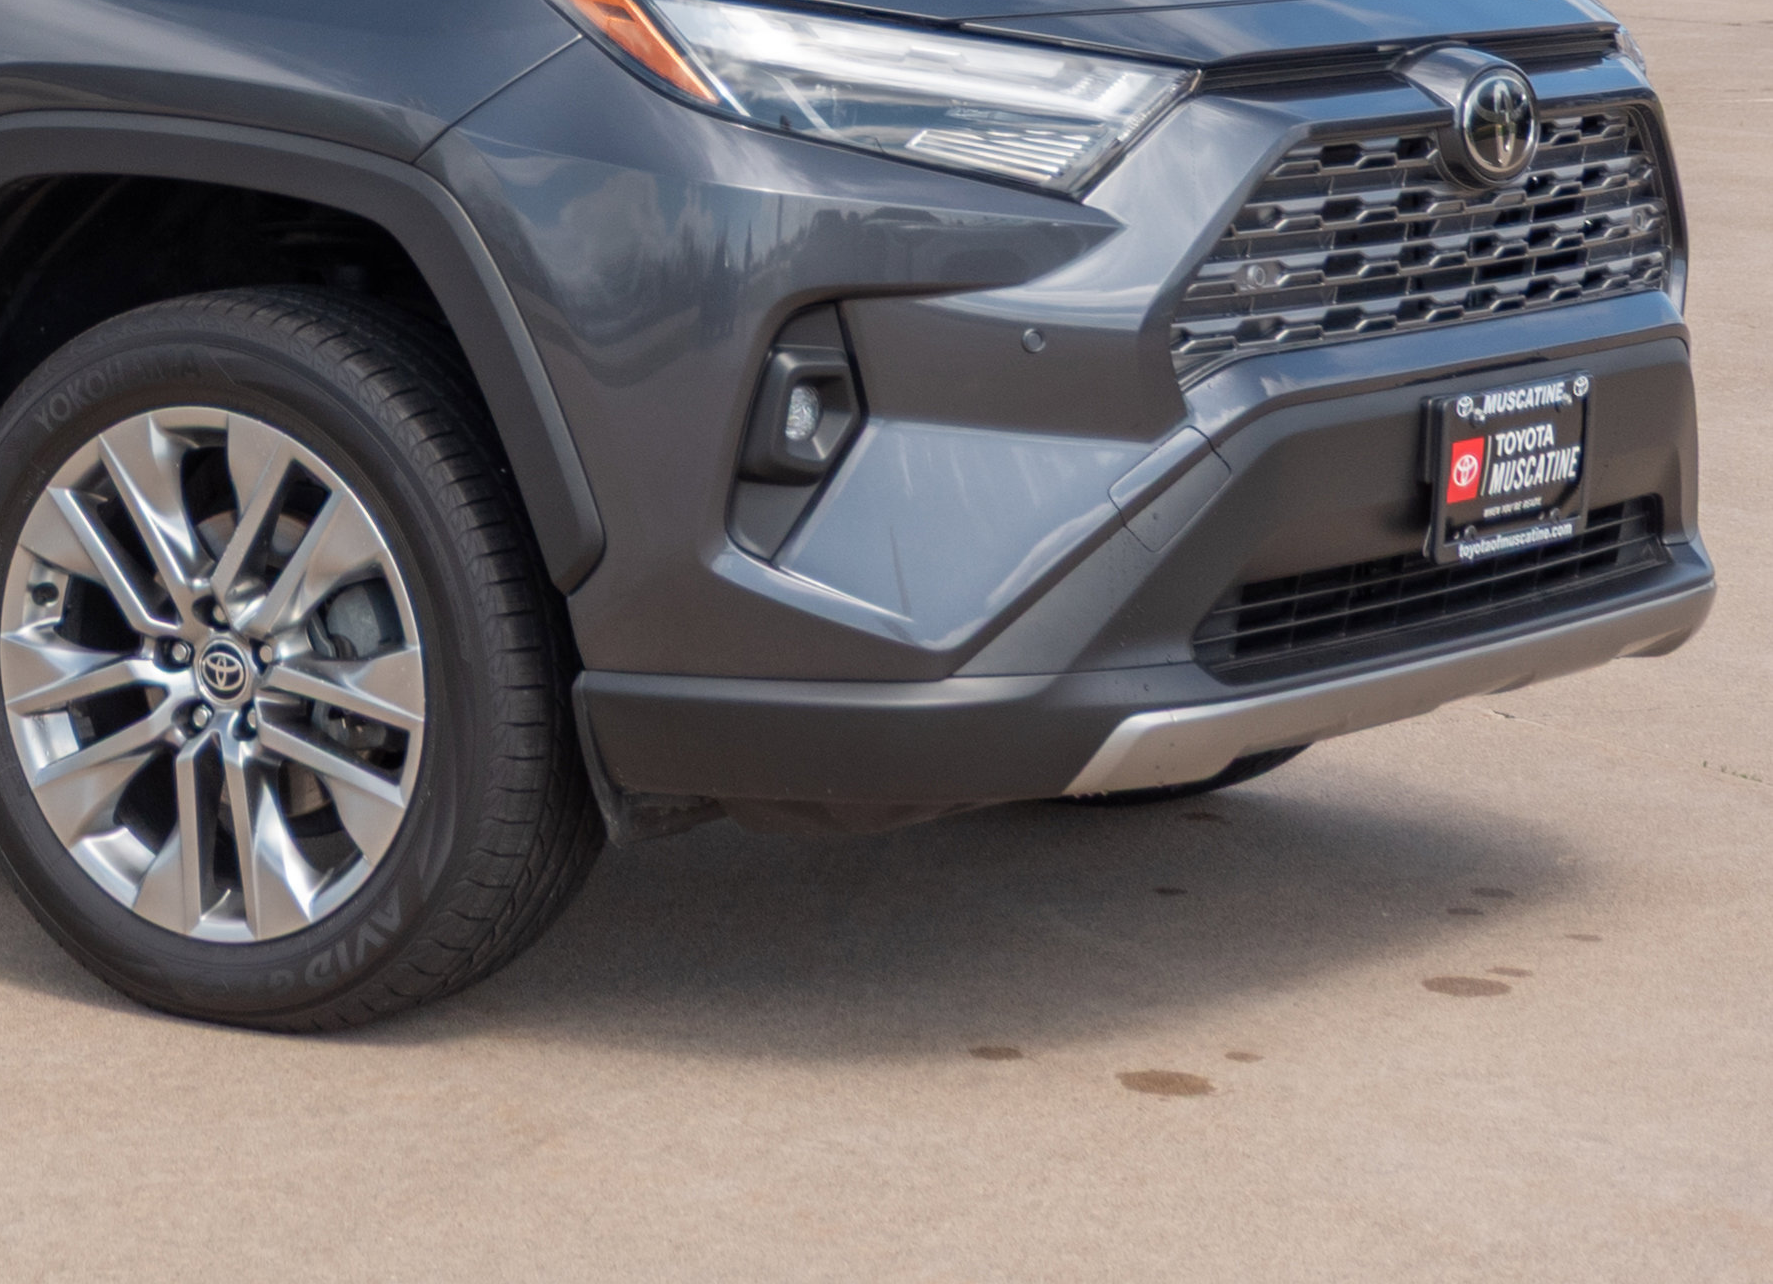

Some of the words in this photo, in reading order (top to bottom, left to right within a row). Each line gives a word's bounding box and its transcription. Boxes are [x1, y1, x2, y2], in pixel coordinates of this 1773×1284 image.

[1482, 381, 1566, 415] MUSCATINE
[1495, 424, 1555, 457] TOYOTA
[1488, 446, 1581, 496] MUSCATINE
[1458, 523, 1573, 560] toyotaofmuscatine.com
[305, 885, 402, 987] AVID
